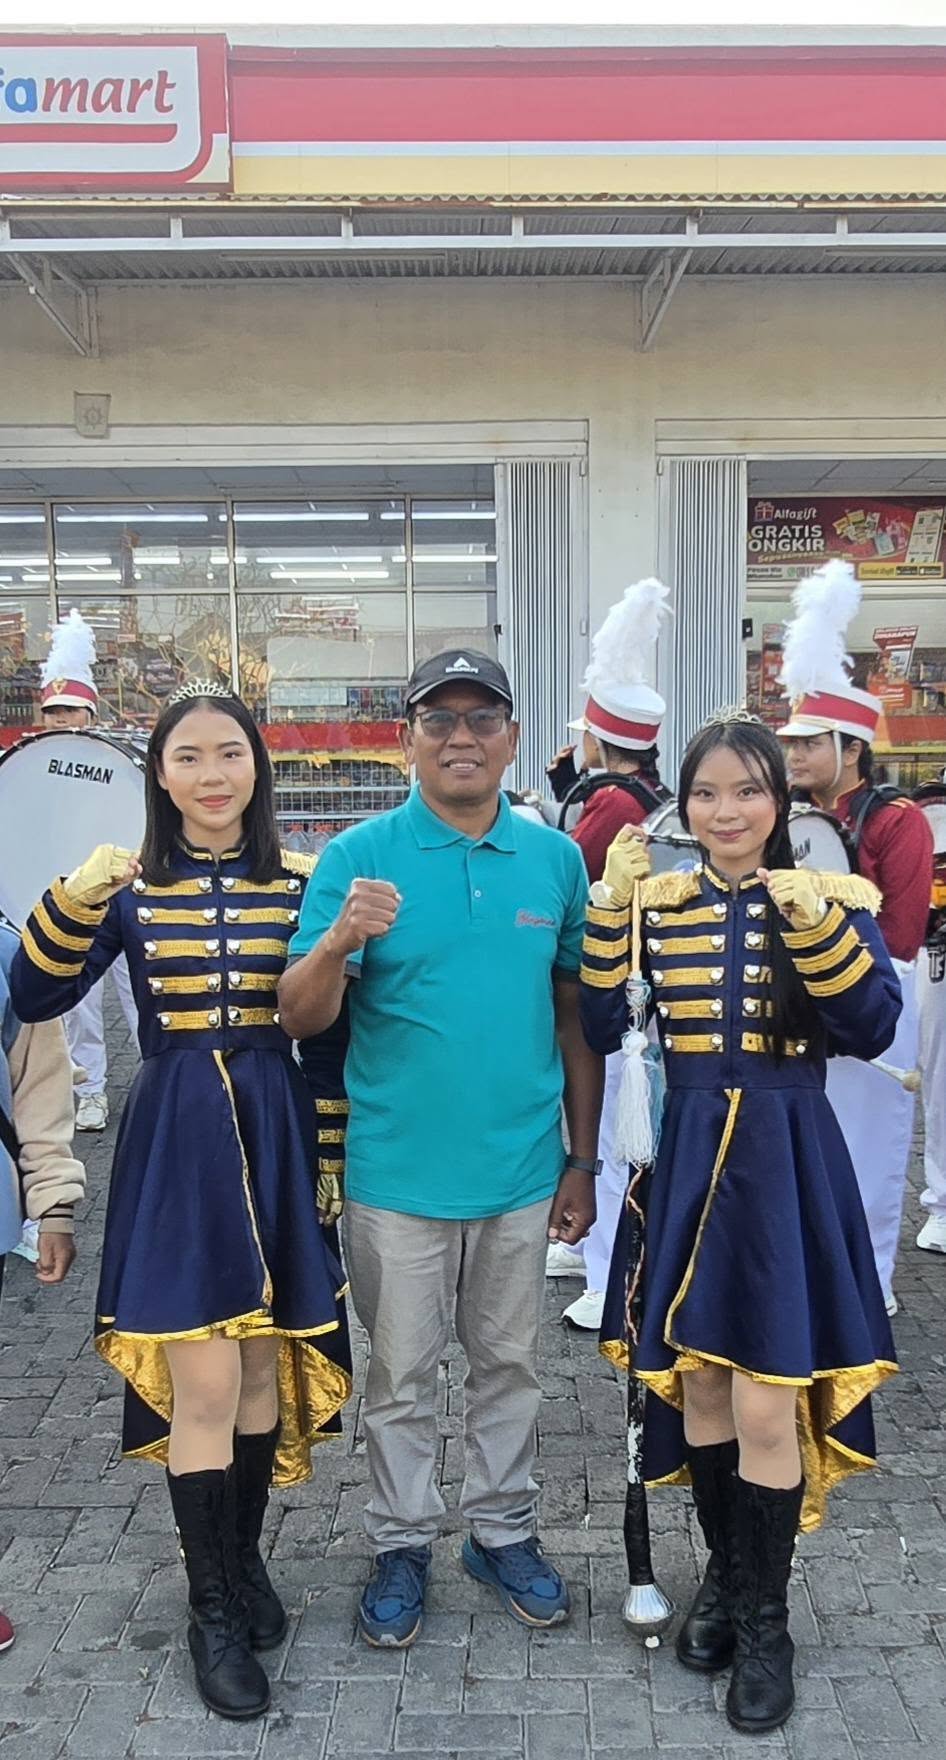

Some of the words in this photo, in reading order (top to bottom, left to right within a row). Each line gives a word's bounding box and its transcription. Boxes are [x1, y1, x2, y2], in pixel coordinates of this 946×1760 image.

[0, 67, 177, 113] amart
[774, 507, 817, 520] Alfagift
[751, 525, 823, 538] GRATIS
[748, 538, 825, 552] ONGKIR
[48, 759, 113, 785] BLASMAN
